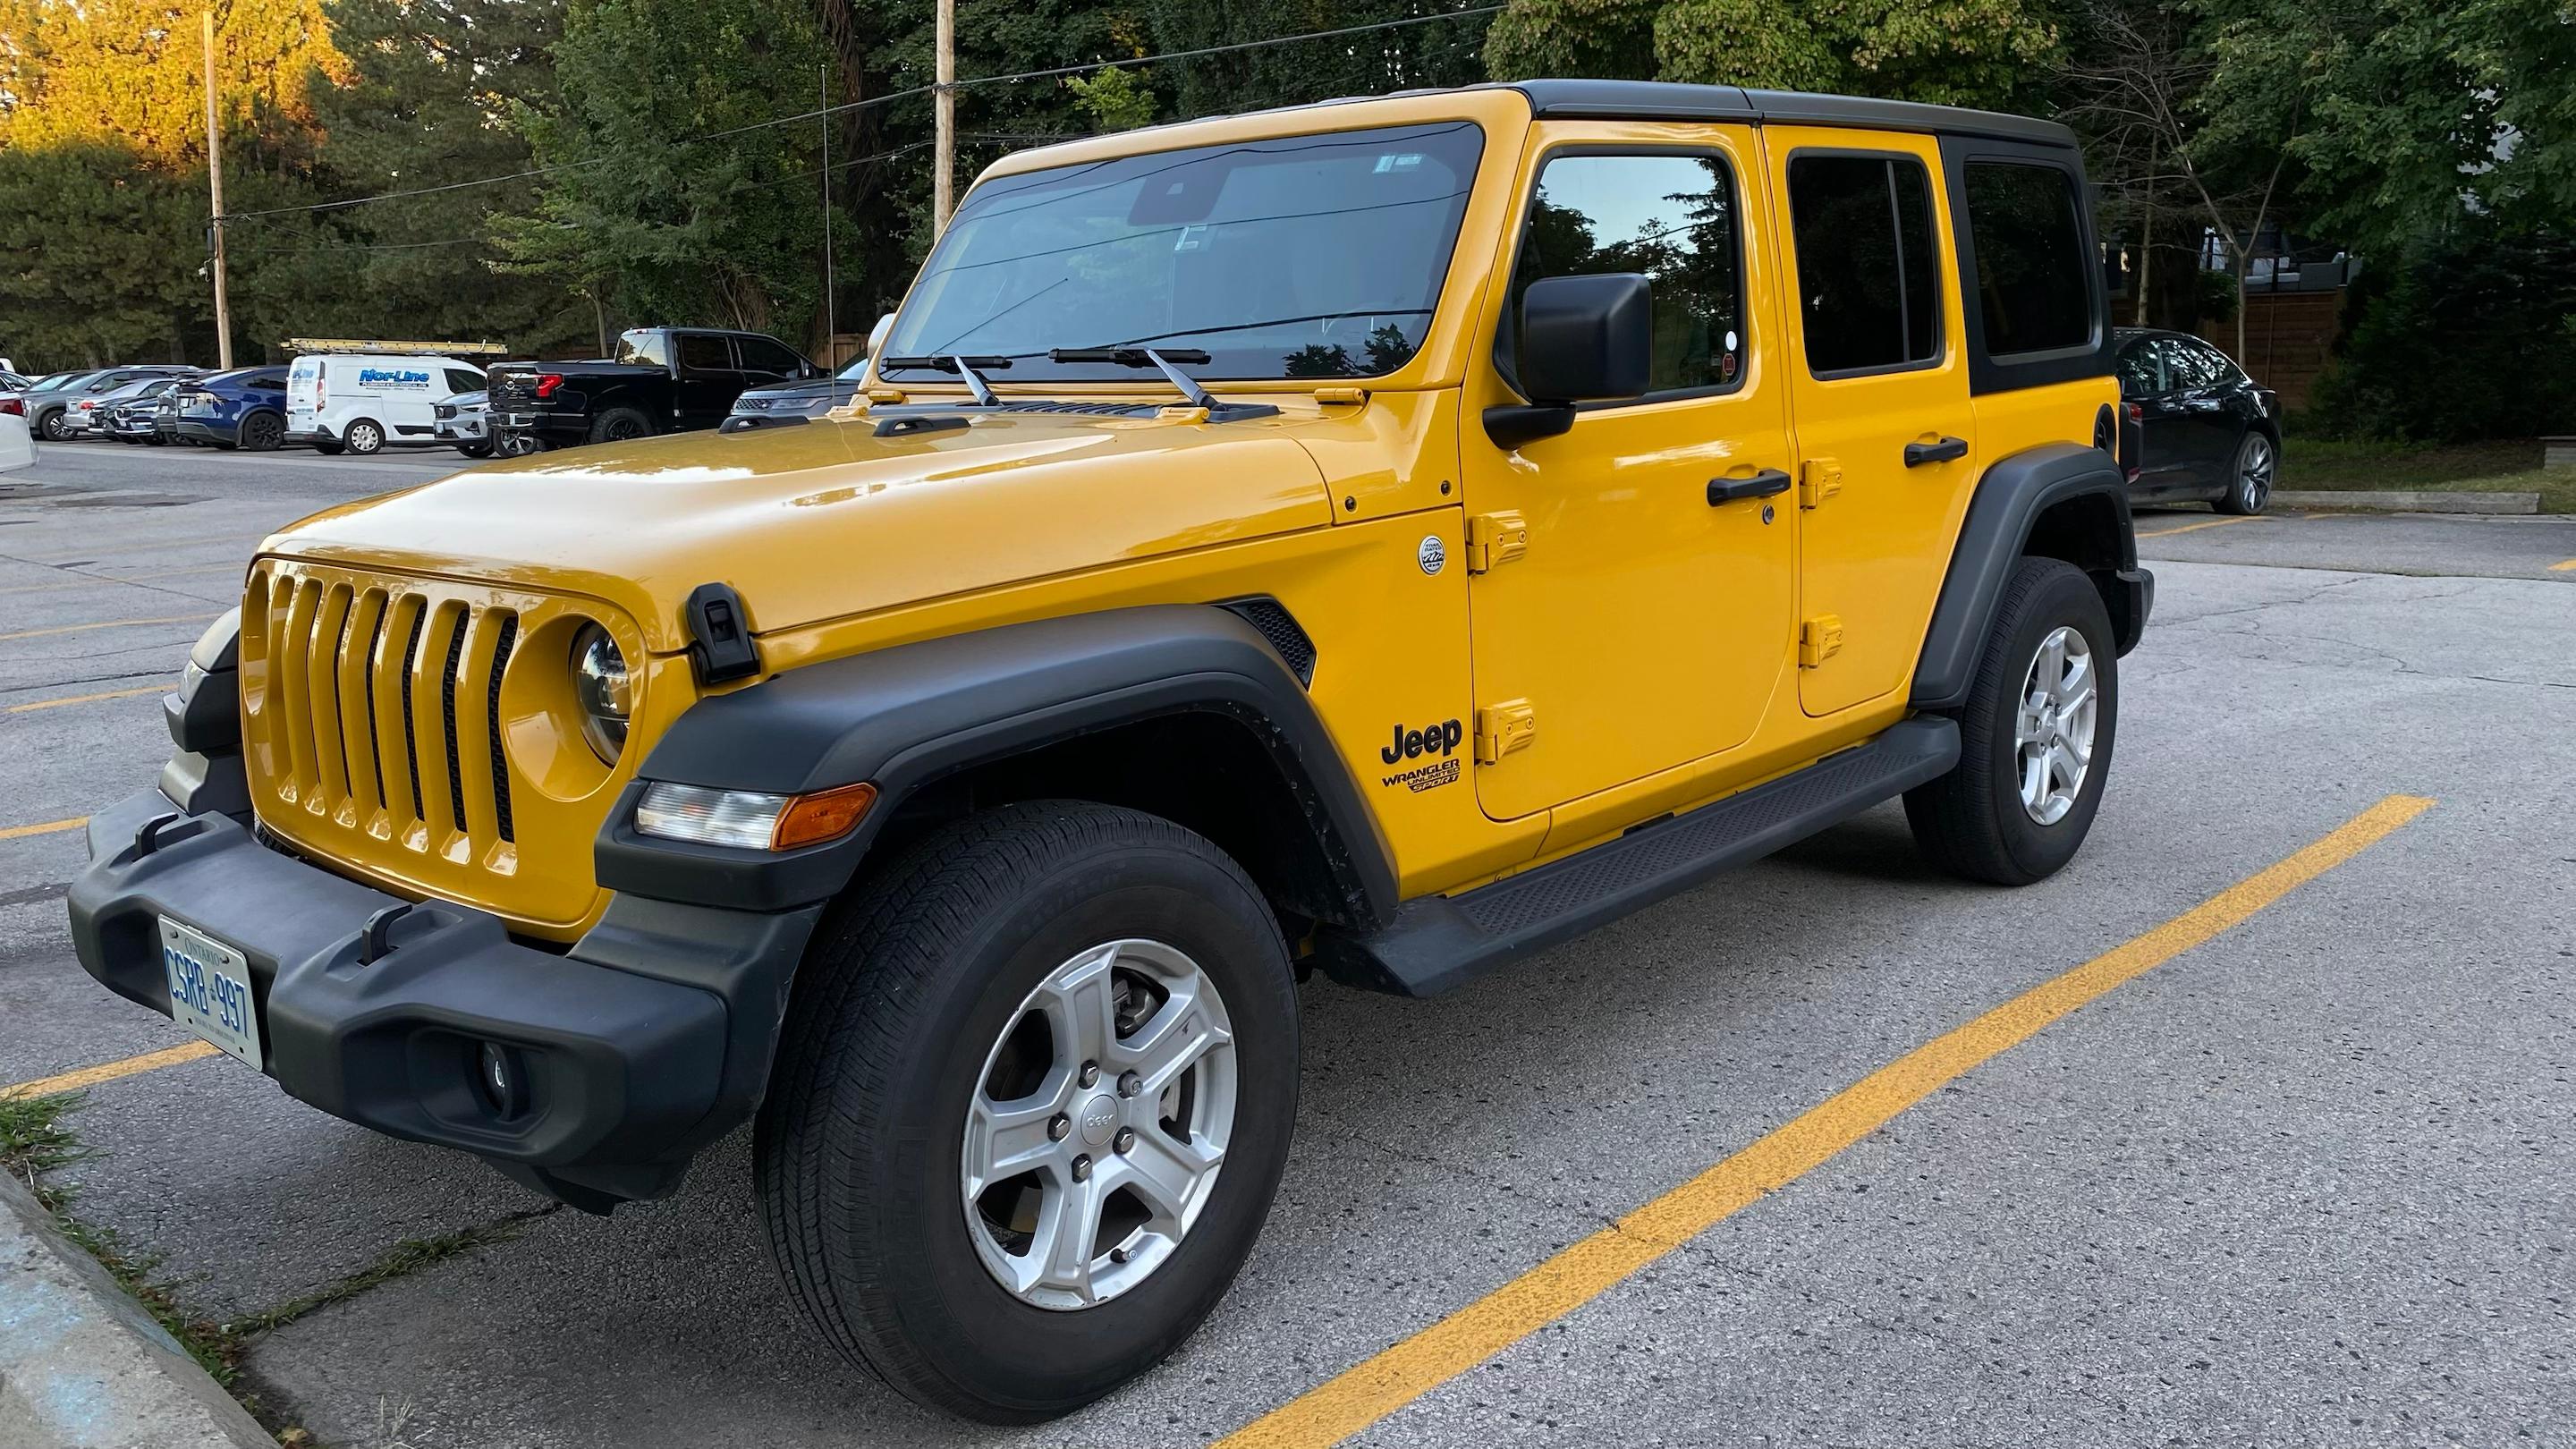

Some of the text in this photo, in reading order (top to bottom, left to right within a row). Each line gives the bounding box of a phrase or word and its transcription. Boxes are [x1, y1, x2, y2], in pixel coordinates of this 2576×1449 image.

[1381, 719, 1462, 765] Jeep
[1382, 758, 1460, 787] WRANGLER
[1407, 767, 1461, 785] UNLIMITED
[1412, 775, 1459, 790] SPORT
